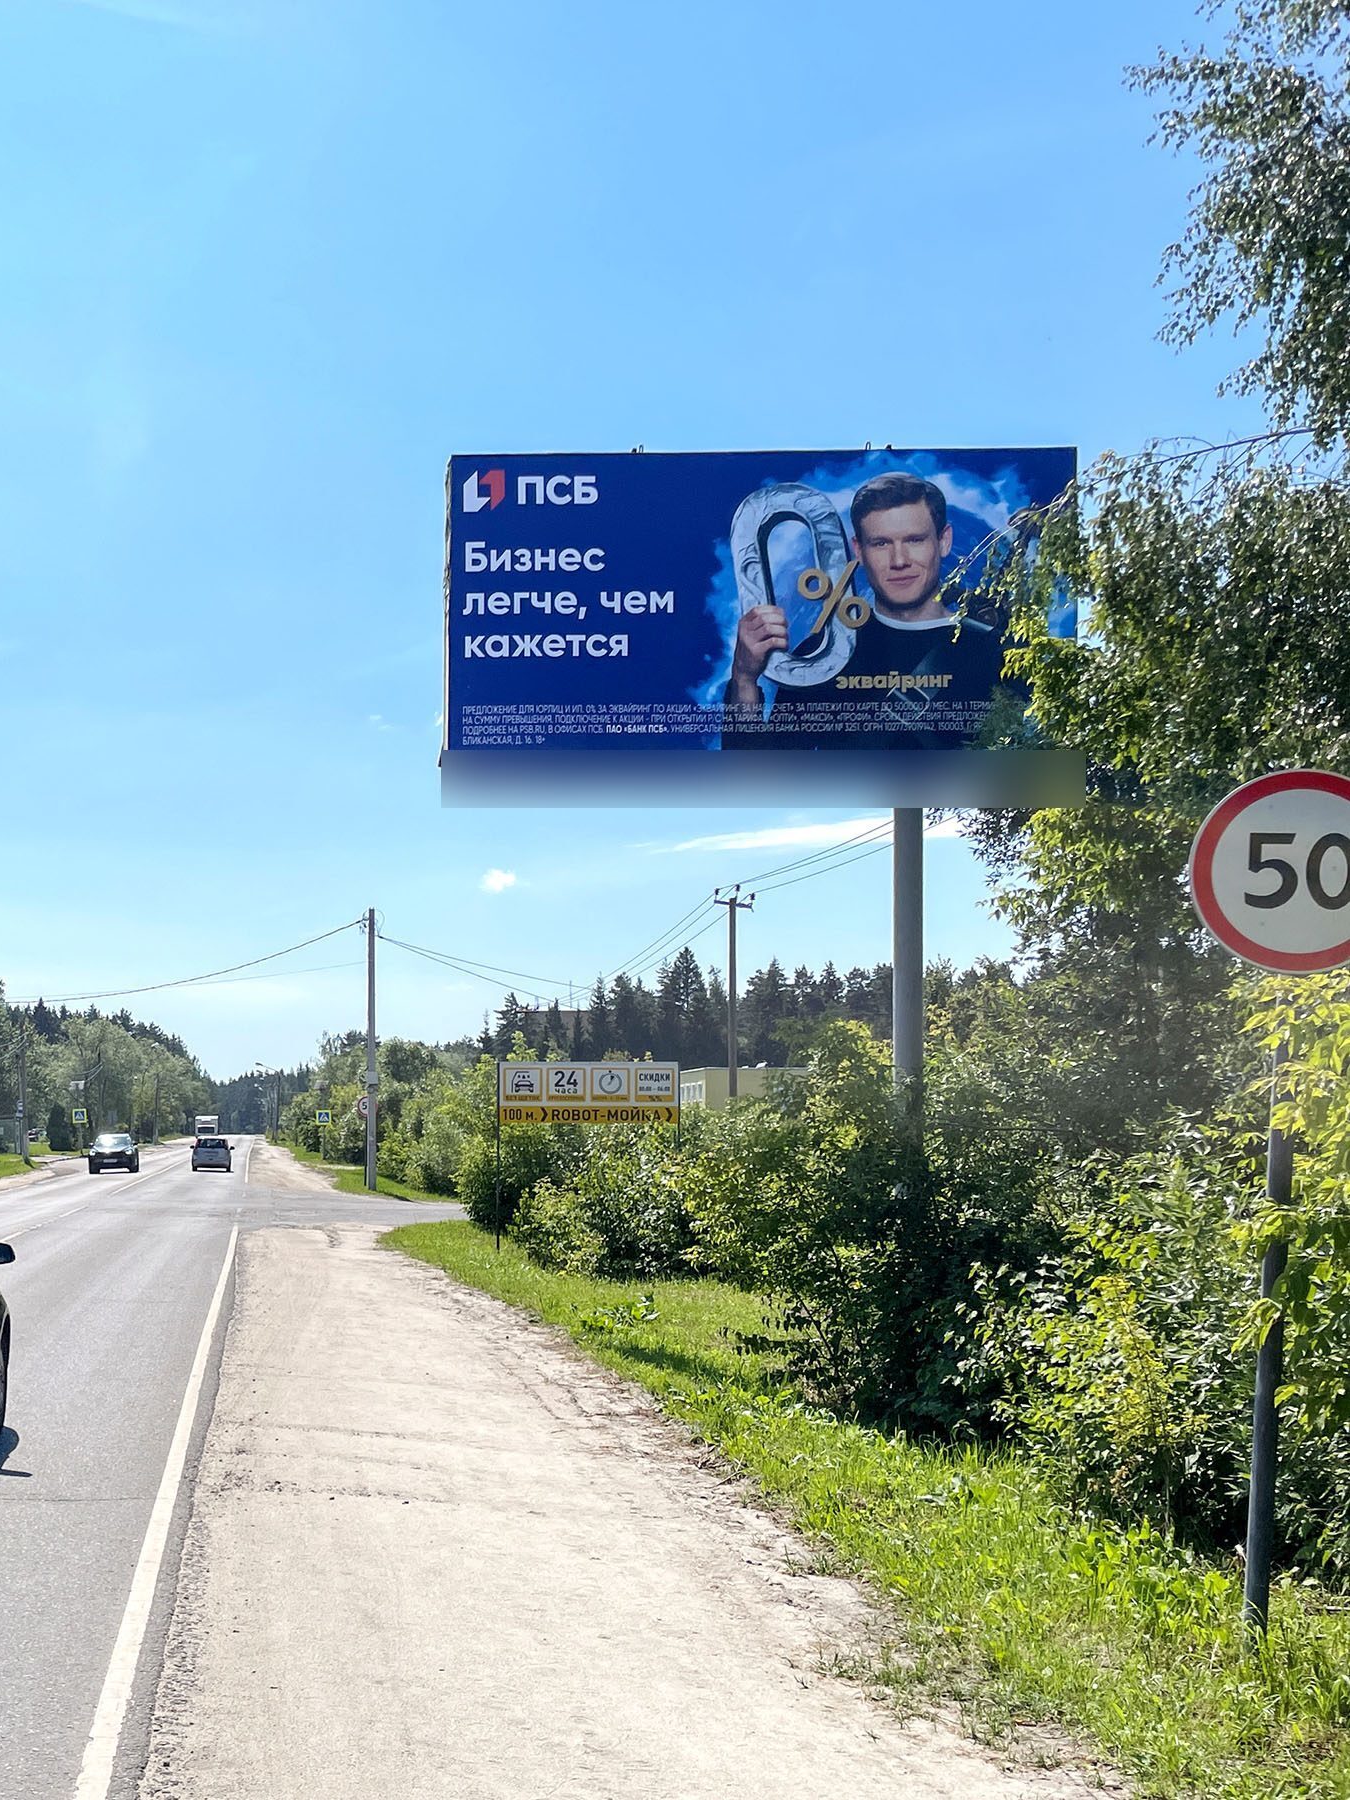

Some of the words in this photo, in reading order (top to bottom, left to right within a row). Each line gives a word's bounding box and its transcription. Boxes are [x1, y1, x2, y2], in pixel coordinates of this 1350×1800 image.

[517, 475, 599, 506] ПСБ
[464, 541, 605, 573] Бизнес
[462, 591, 587, 620] легче,
[599, 591, 674, 614] чем
[463, 633, 629, 658] кажется
[835, 672, 953, 694] эквайринг
[462, 705, 517, 715] ПРЕДЛОЖЕНИЕ
[519, 705, 535, 715] ДЛЯ
[536, 704, 564, 715] ЮРЛИЦ
[565, 705, 571, 713] И
[572, 704, 585, 714] ИП.
[586, 704, 597, 714] 0%
[598, 704, 608, 713] ЗА
[609, 702, 652, 713] ЭКВАЙРИНГ
[653, 704, 665, 713] ПО
[666, 704, 692, 714] АКЦИИ
[693, 702, 740, 713] «ЭКВАЙРИНГ
[741, 703, 752, 712] ЗА
[753, 703, 771, 712] НА
[771, 703, 795, 712] СЧЕТ»
[796, 702, 806, 712] ЗА
[807, 702, 842, 712] ПЛАТЕЖИ
[843, 702, 856, 712] ПО
[857, 702, 880, 712] КАРТЕ
[881, 702, 893, 712] ДО
[952, 702, 963, 711] НА
[964, 702, 968, 710] 1
[462, 716, 473, 725] НА
[474, 715, 501, 725] СУММУ
[554, 714, 611, 724] ПОДКЛЮЧЕНИЕ
[612, 714, 619, 723] К
[620, 714, 645, 724] АКЦИИ
[651, 714, 666, 723] ПРИ
[667, 714, 707, 723] ОТКРЫТИИ
[723, 713, 733, 722] НА
[734, 713, 769, 722] ТАРИФА
[462, 725, 507, 735] ПОДРОБНЕЕ
[508, 725, 518, 734] НА
[519, 725, 547, 735] PSB.RU,
[548, 725, 554, 734] В
[554, 725, 587, 734] ОФИСАХ
[606, 724, 623, 733] ПАО
[624, 724, 647, 733] «БАНК
[670, 723, 734, 733] УНИВЕРСАЛЬНАЯ
[735, 723, 774, 733] ЛИЦЕНЗИЯ
[775, 722, 800, 732] БАНКА
[801, 722, 834, 732] РОССИИ
[863, 722, 884, 732] ОГРН
[462, 735, 514, 746] БЛИКАНСКАЯ,
[535, 735, 546, 744] 18+
[1245, 833, 1350, 911] 50
[554, 1070, 579, 1088] 24
[639, 1073, 671, 1083] СКИДКИ
[504, 1109, 522, 1121] 100
[526, 1111, 538, 1121] м.
